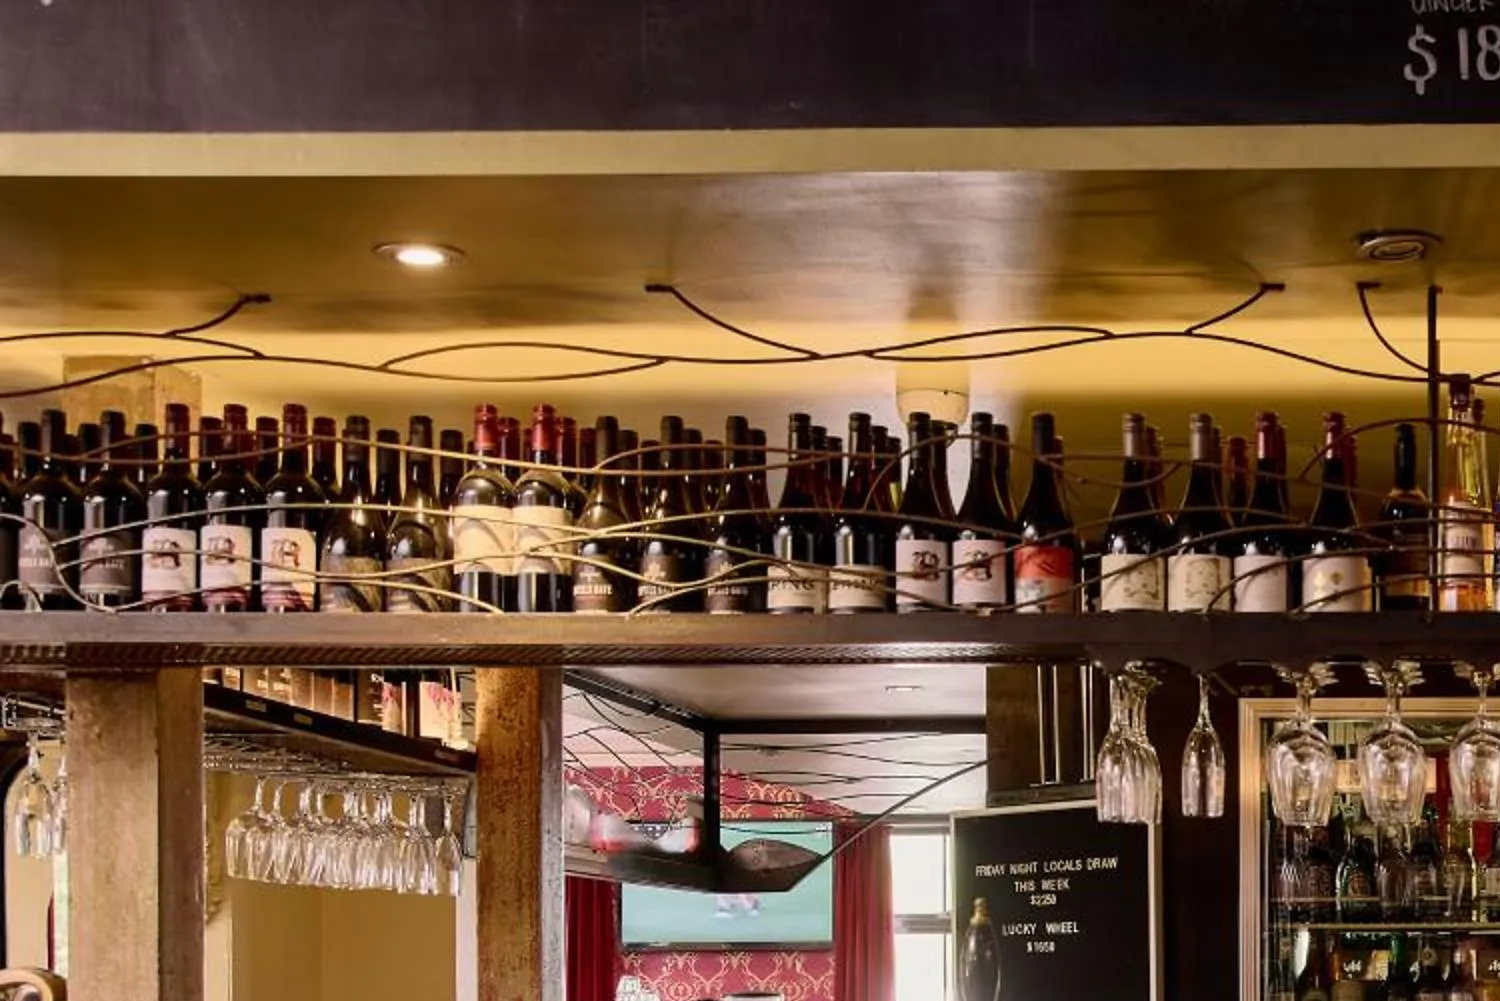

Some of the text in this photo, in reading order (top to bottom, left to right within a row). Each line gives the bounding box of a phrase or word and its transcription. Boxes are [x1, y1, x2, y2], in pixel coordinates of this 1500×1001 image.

[975, 856, 1119, 877] FRIDAY NIGHT LOCALS DRAW
[1014, 878, 1071, 893] THIS WEEK
[1002, 921, 1080, 936] LUCKY WHEEL
